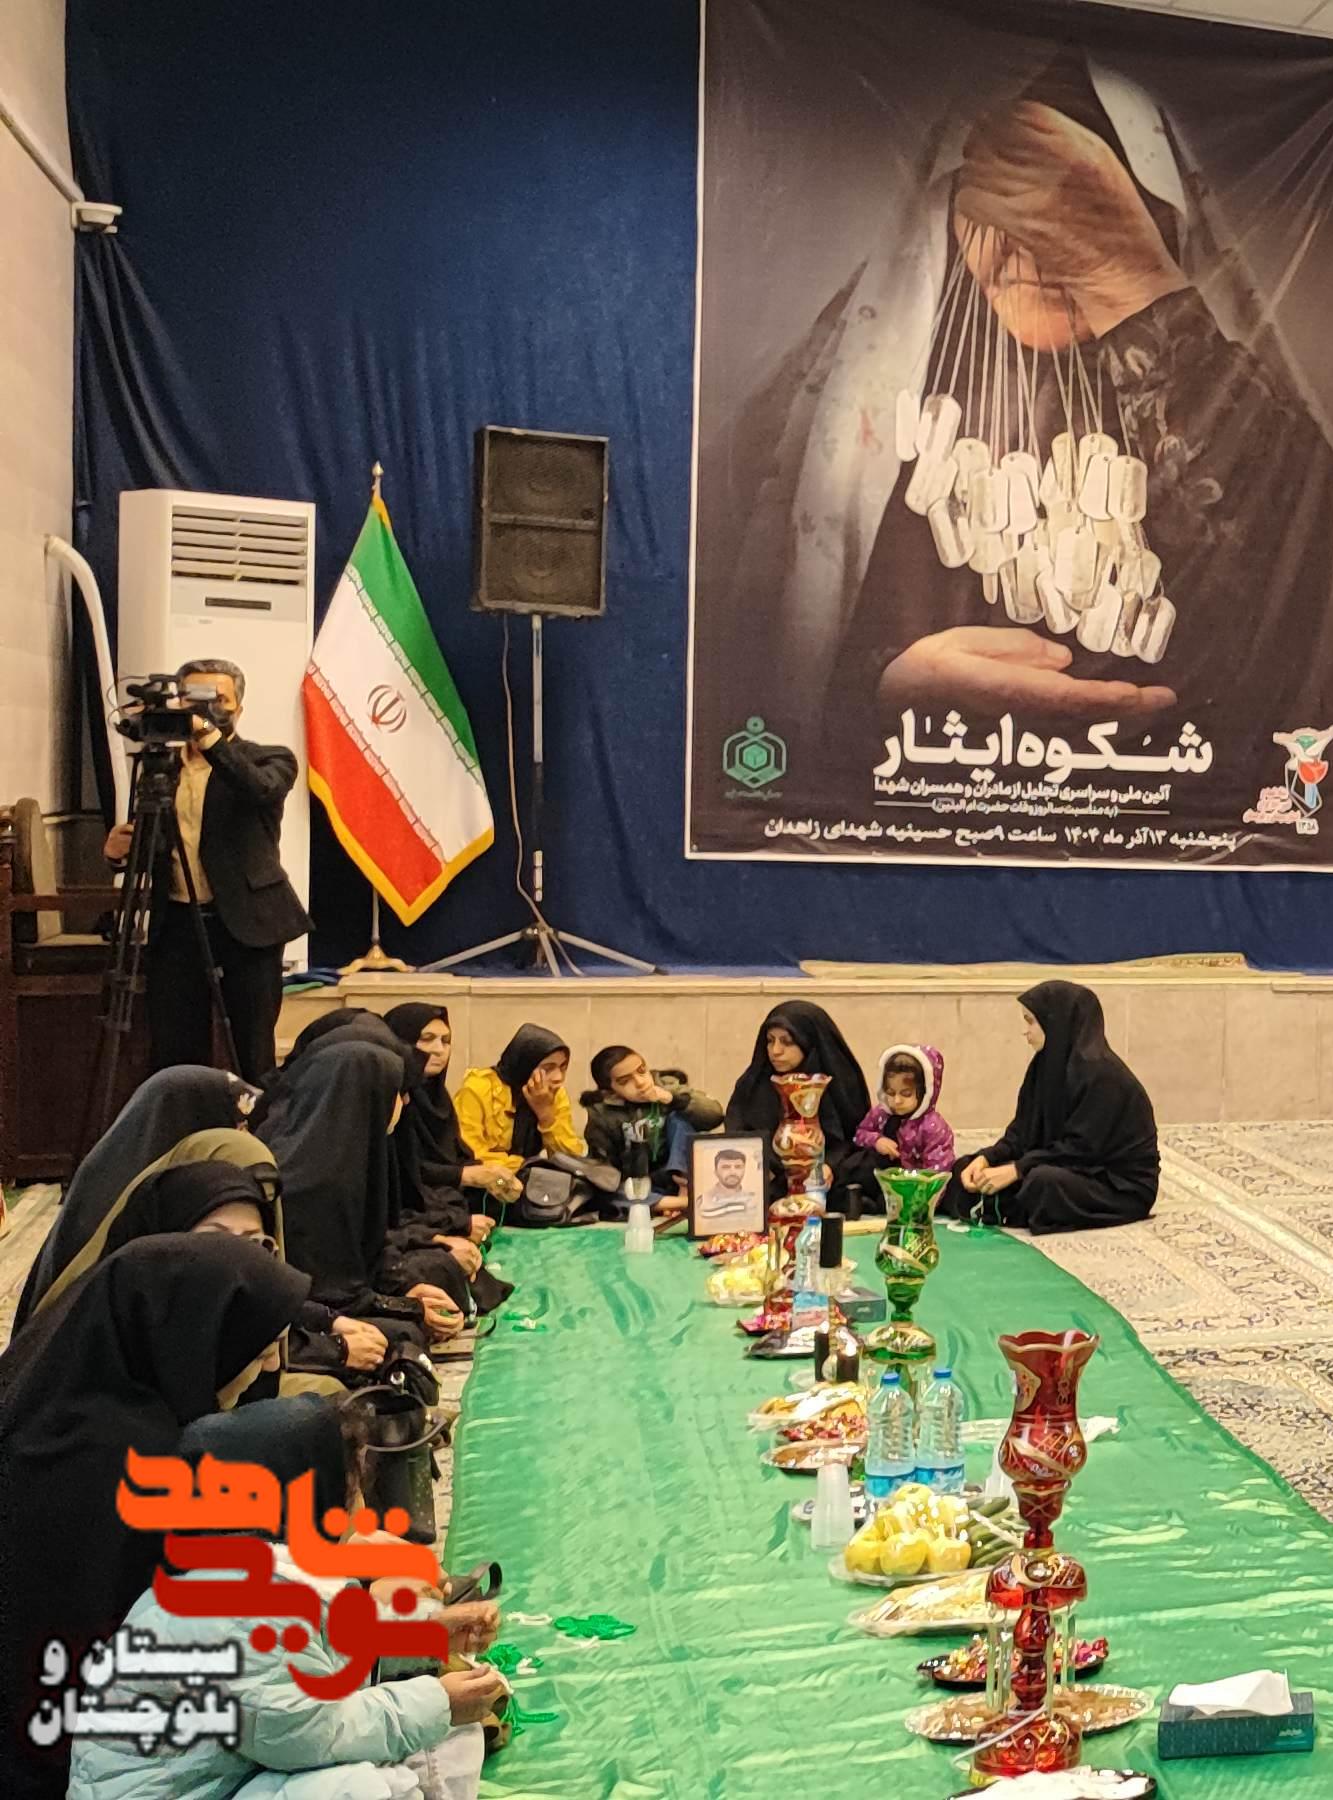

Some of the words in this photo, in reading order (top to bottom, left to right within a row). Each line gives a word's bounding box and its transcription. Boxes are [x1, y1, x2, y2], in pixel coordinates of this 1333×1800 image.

[872, 707, 1015, 784] ایثار
[1016, 720, 1214, 785] شکوه
[873, 775, 911, 796] شهدا
[909, 776, 964, 796] همسران
[972, 780, 1011, 799] مادران
[1009, 781, 1022, 800] از
[1021, 781, 1060, 801] تجلیل
[1059, 782, 1111, 801] سراسری
[1118, 784, 1142, 804] ملی
[764, 816, 821, 840] زاهدان
[823, 819, 883, 841] شهدای
[886, 822, 953, 843] حسینیه
[1007, 825, 1057, 843] ساعت
[1102, 827, 1124, 845] ماه
[1169, 830, 1237, 853] پنجشنبه
